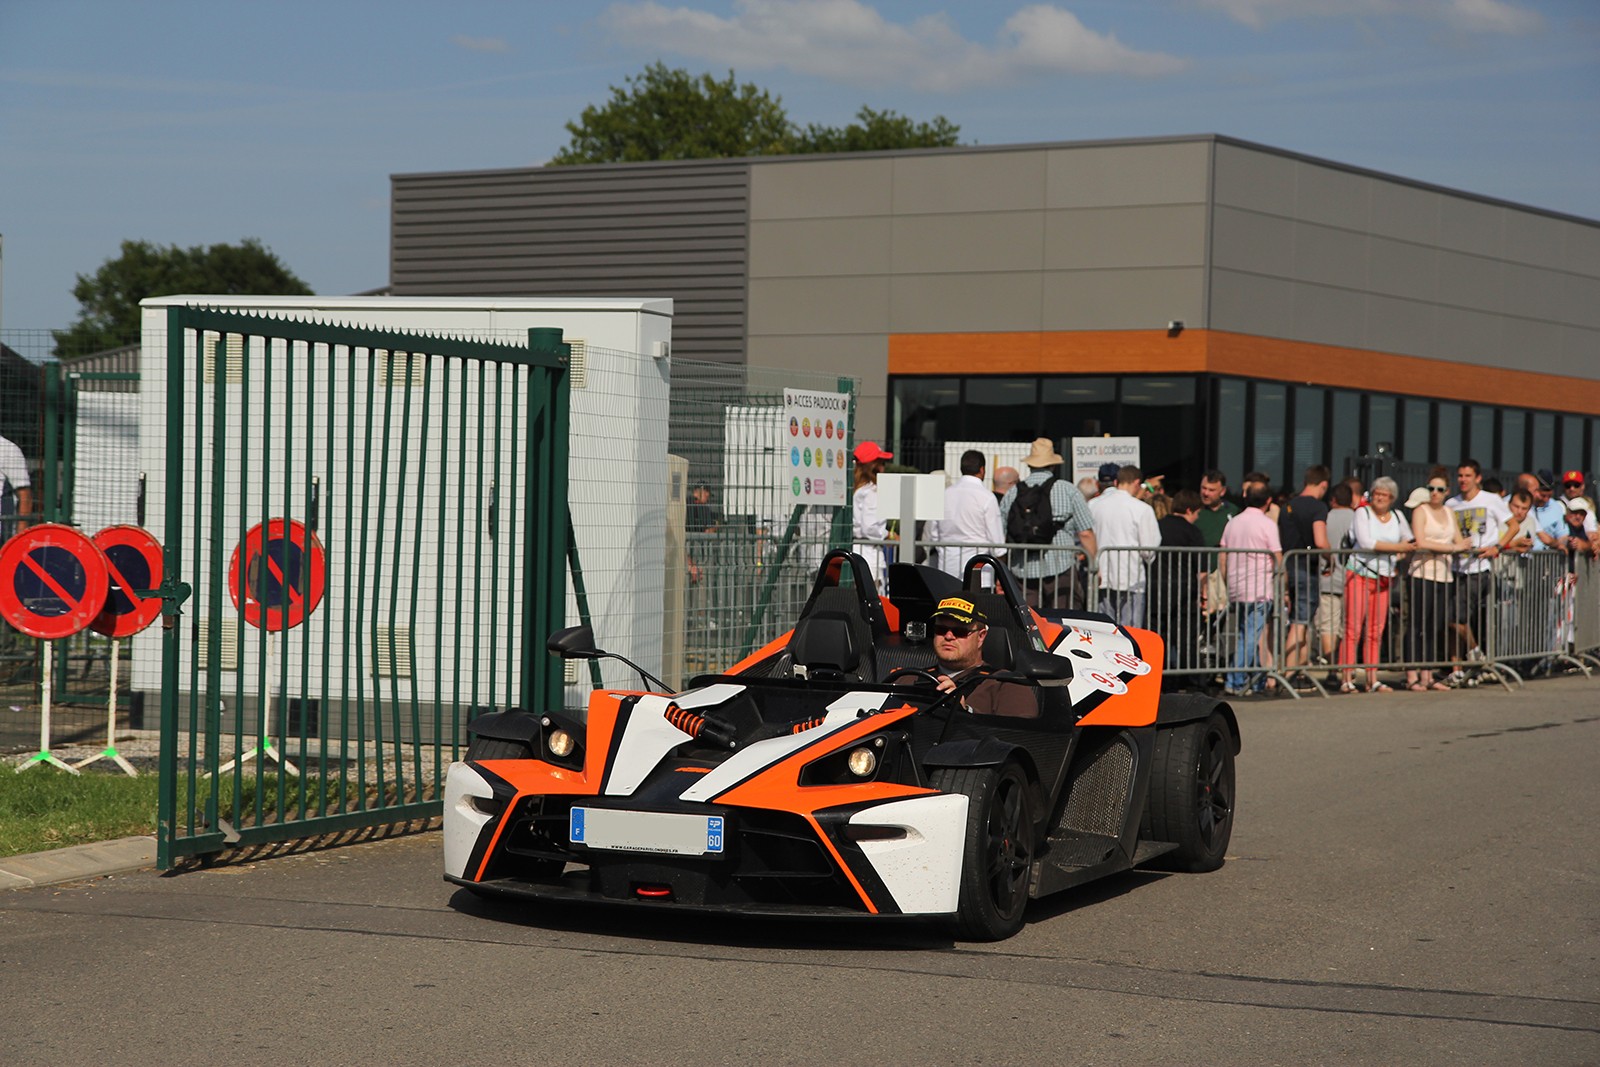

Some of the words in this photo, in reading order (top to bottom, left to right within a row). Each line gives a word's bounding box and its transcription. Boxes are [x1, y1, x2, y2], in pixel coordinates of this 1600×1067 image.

[794, 394, 813, 408] ACCES
[813, 396, 840, 410] PADDOCK
[1076, 445, 1098, 457] sport
[939, 599, 972, 611] PIRELLI
[575, 828, 580, 836] F
[708, 834, 721, 847] 60
